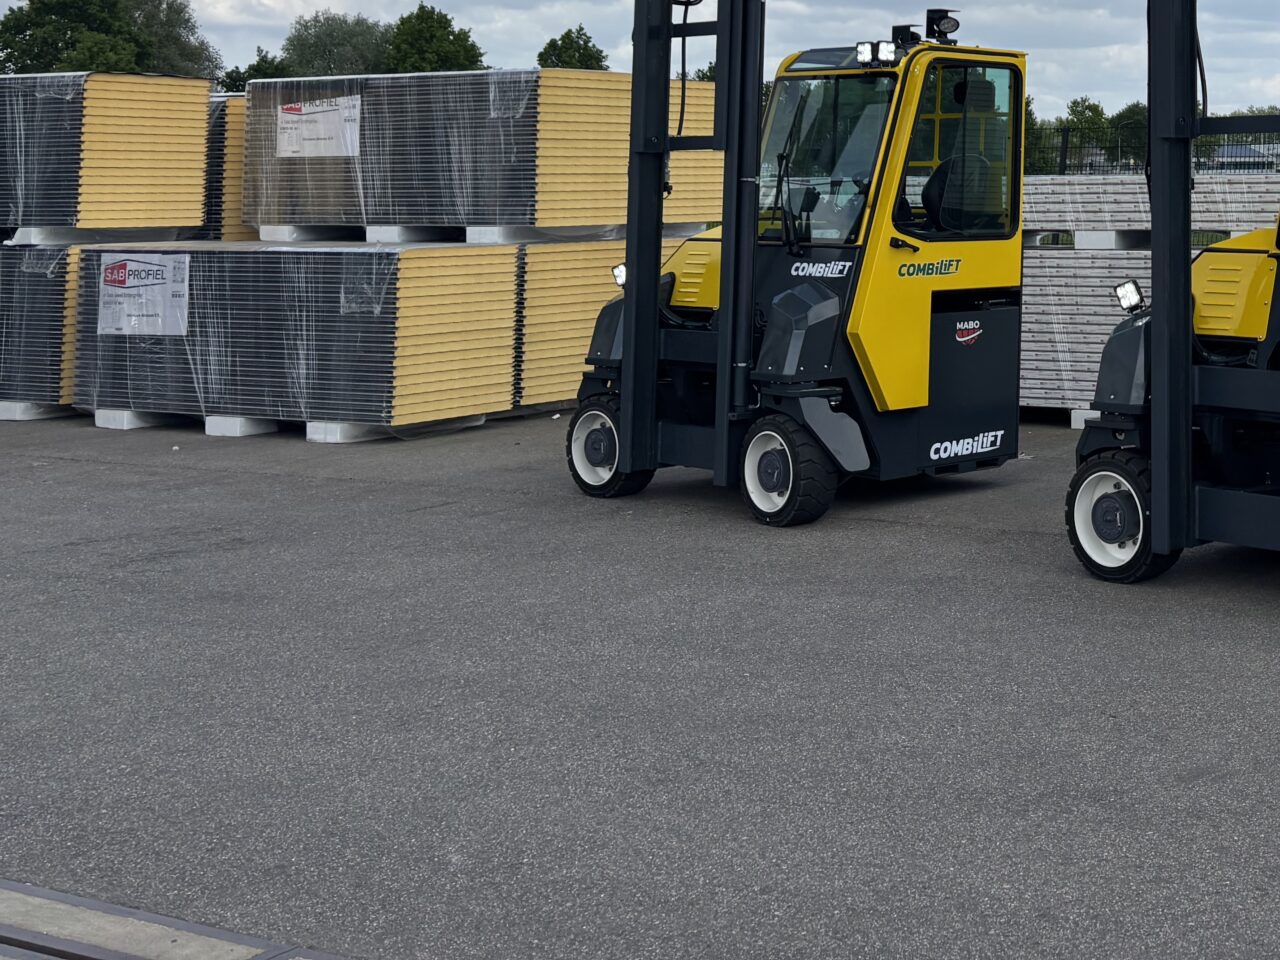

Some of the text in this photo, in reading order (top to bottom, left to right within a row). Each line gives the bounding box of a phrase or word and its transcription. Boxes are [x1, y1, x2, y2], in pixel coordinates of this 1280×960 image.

[105, 268, 167, 281] SAB PROFIEL
[956, 320, 980, 330] MABO
